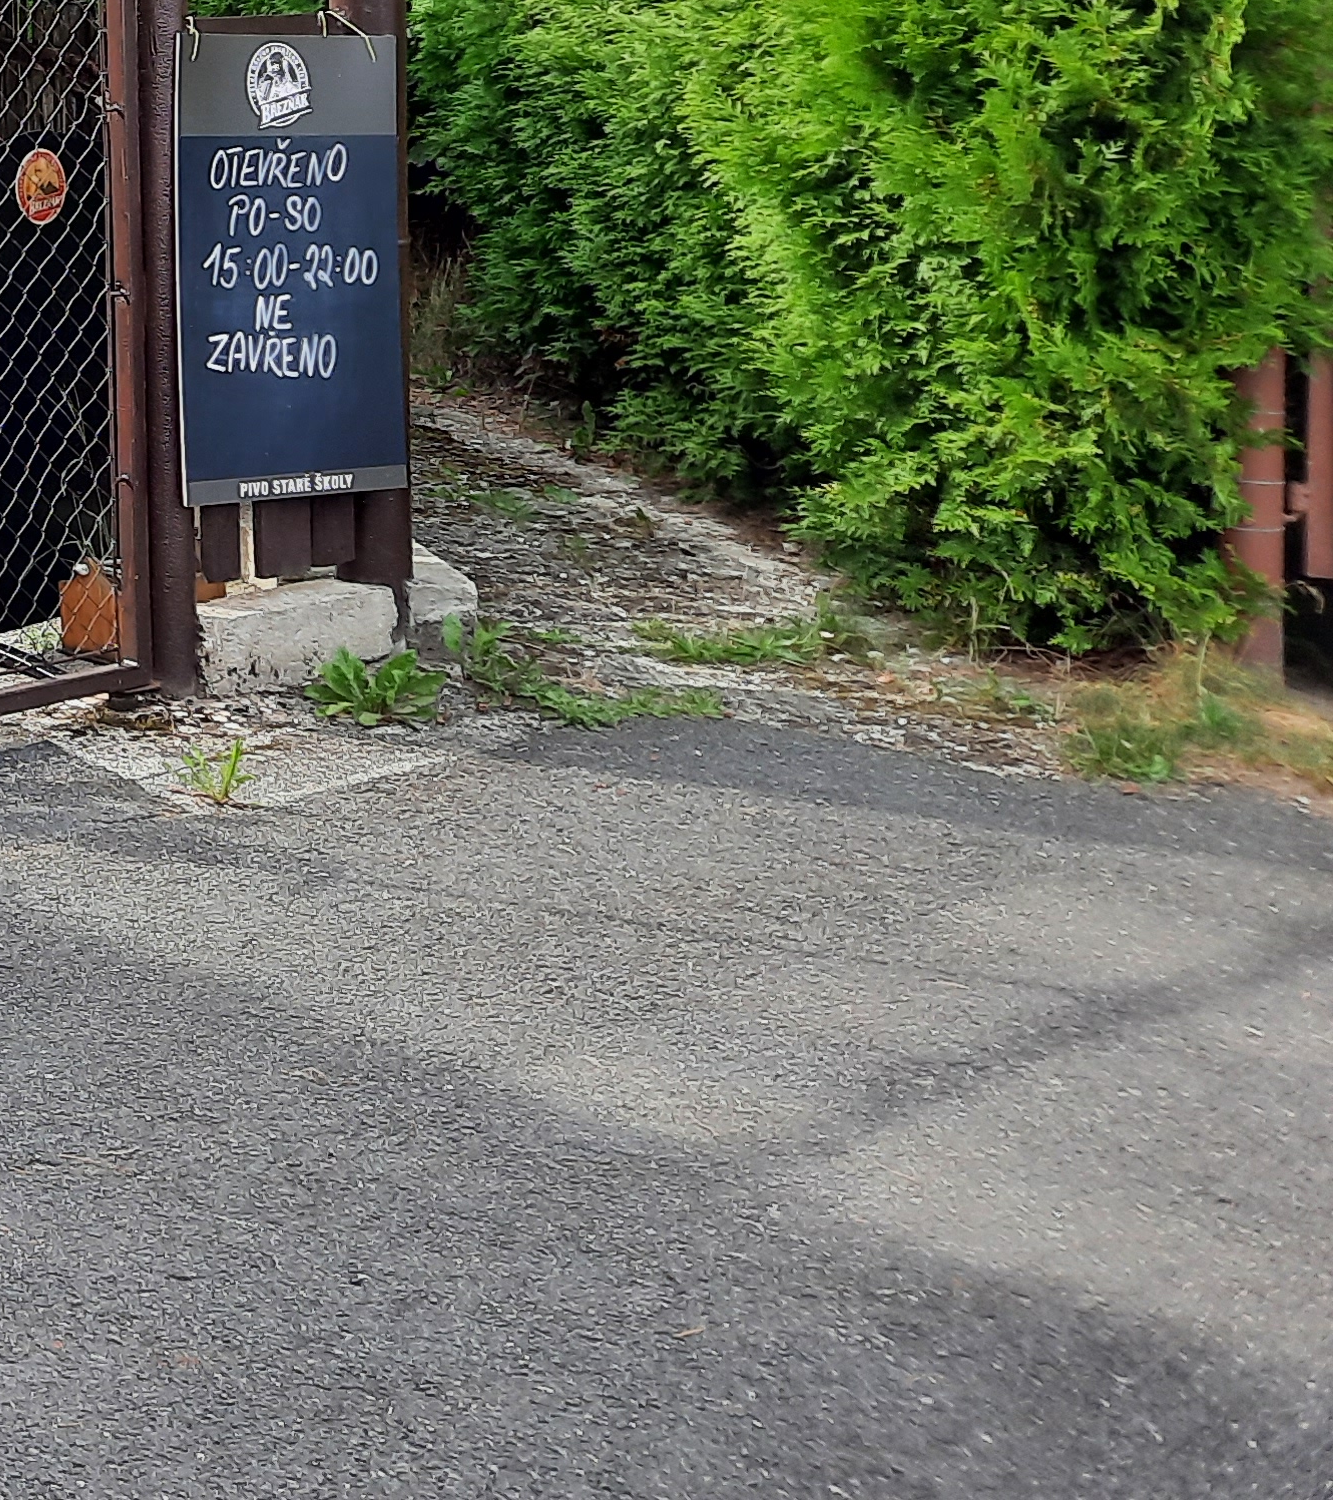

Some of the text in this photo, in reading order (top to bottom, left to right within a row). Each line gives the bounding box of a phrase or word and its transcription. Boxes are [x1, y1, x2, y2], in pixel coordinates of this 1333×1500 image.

[209, 137, 348, 190] OTEVŘENO
[228, 194, 322, 237] PO-SO
[255, 293, 293, 332] NE
[205, 330, 337, 379] ZAVŘENO
[238, 473, 354, 498] PIVO STARÉ ŠKOLY
